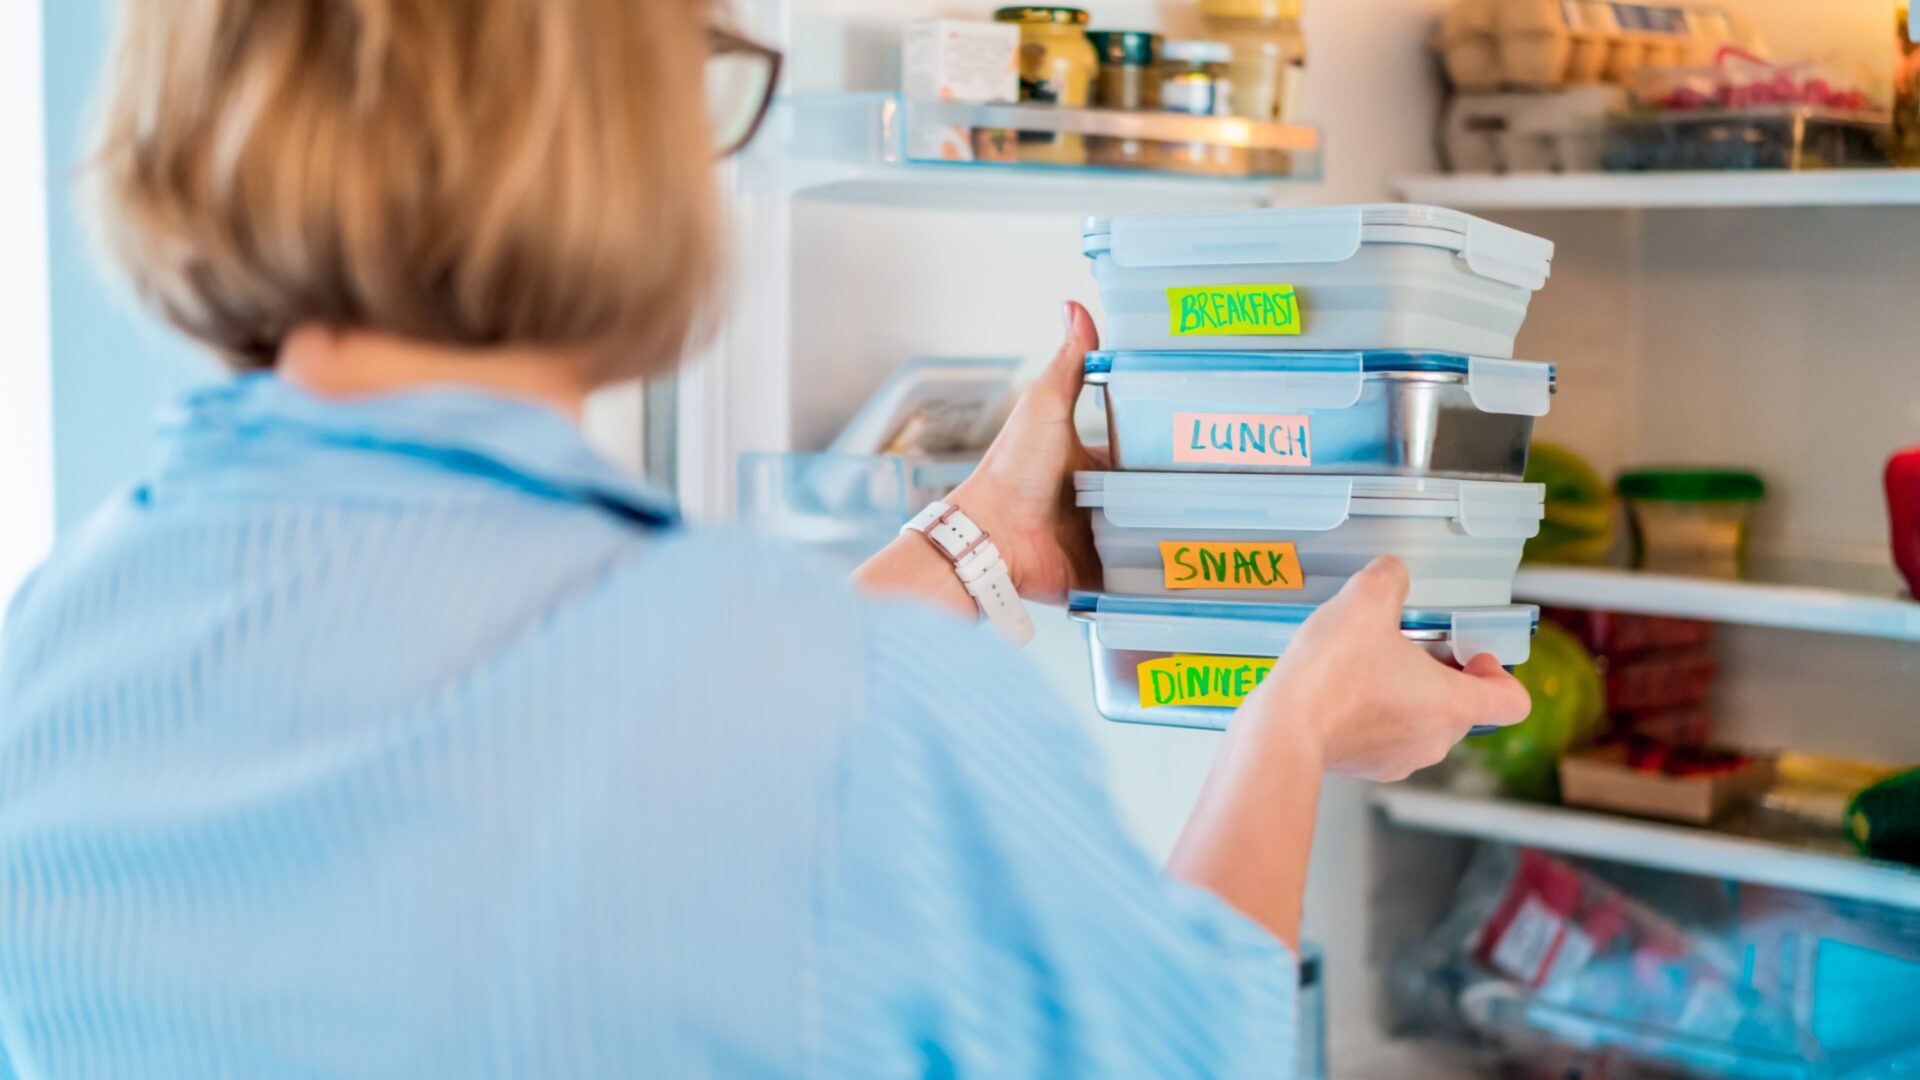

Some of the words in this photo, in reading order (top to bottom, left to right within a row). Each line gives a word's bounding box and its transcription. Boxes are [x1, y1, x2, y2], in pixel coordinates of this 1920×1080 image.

[1180, 292, 1295, 332] BREAKFAST
[1191, 419, 1307, 458] LUNCH
[1174, 547, 1288, 585] SNACK
